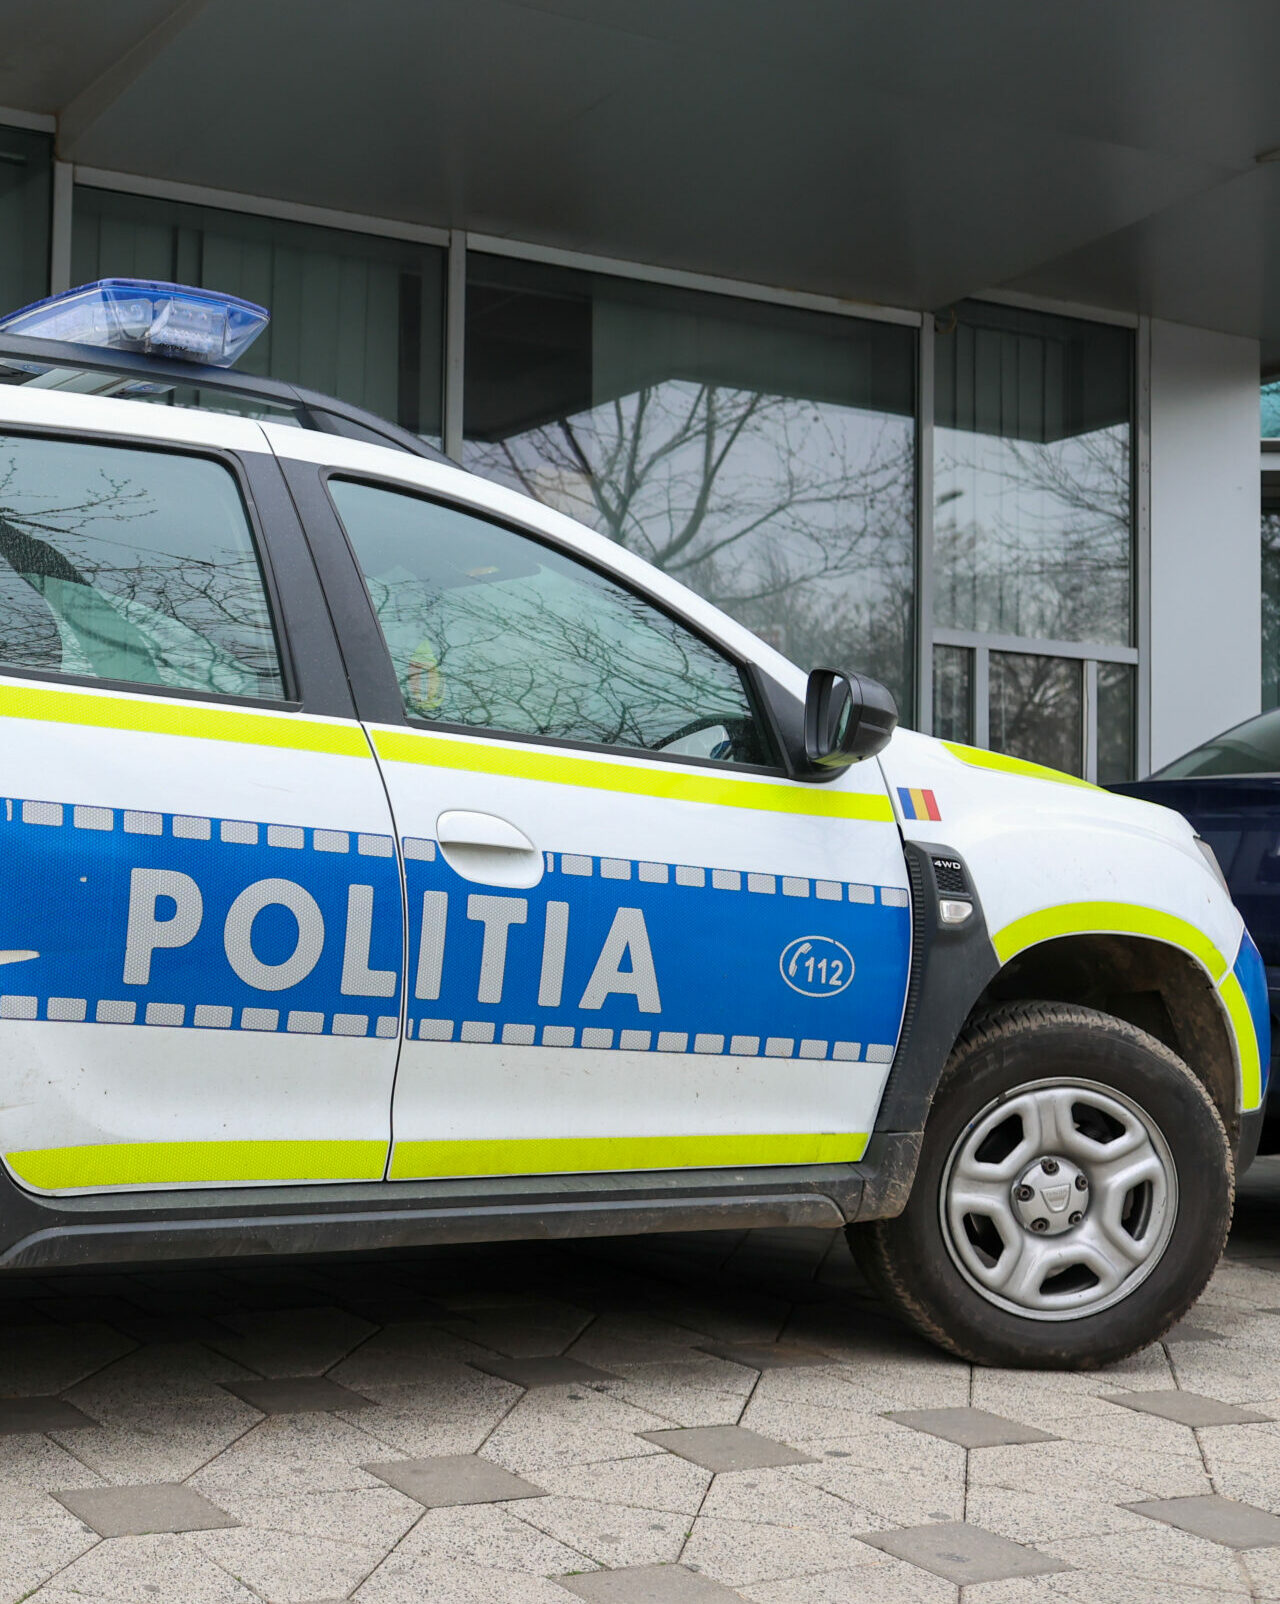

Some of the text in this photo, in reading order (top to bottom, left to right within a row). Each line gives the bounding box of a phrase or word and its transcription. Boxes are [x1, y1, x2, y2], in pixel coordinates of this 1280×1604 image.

[933, 860, 961, 870] 4WD
[123, 867, 662, 1014] POLITIA
[805, 957, 843, 986] 112
